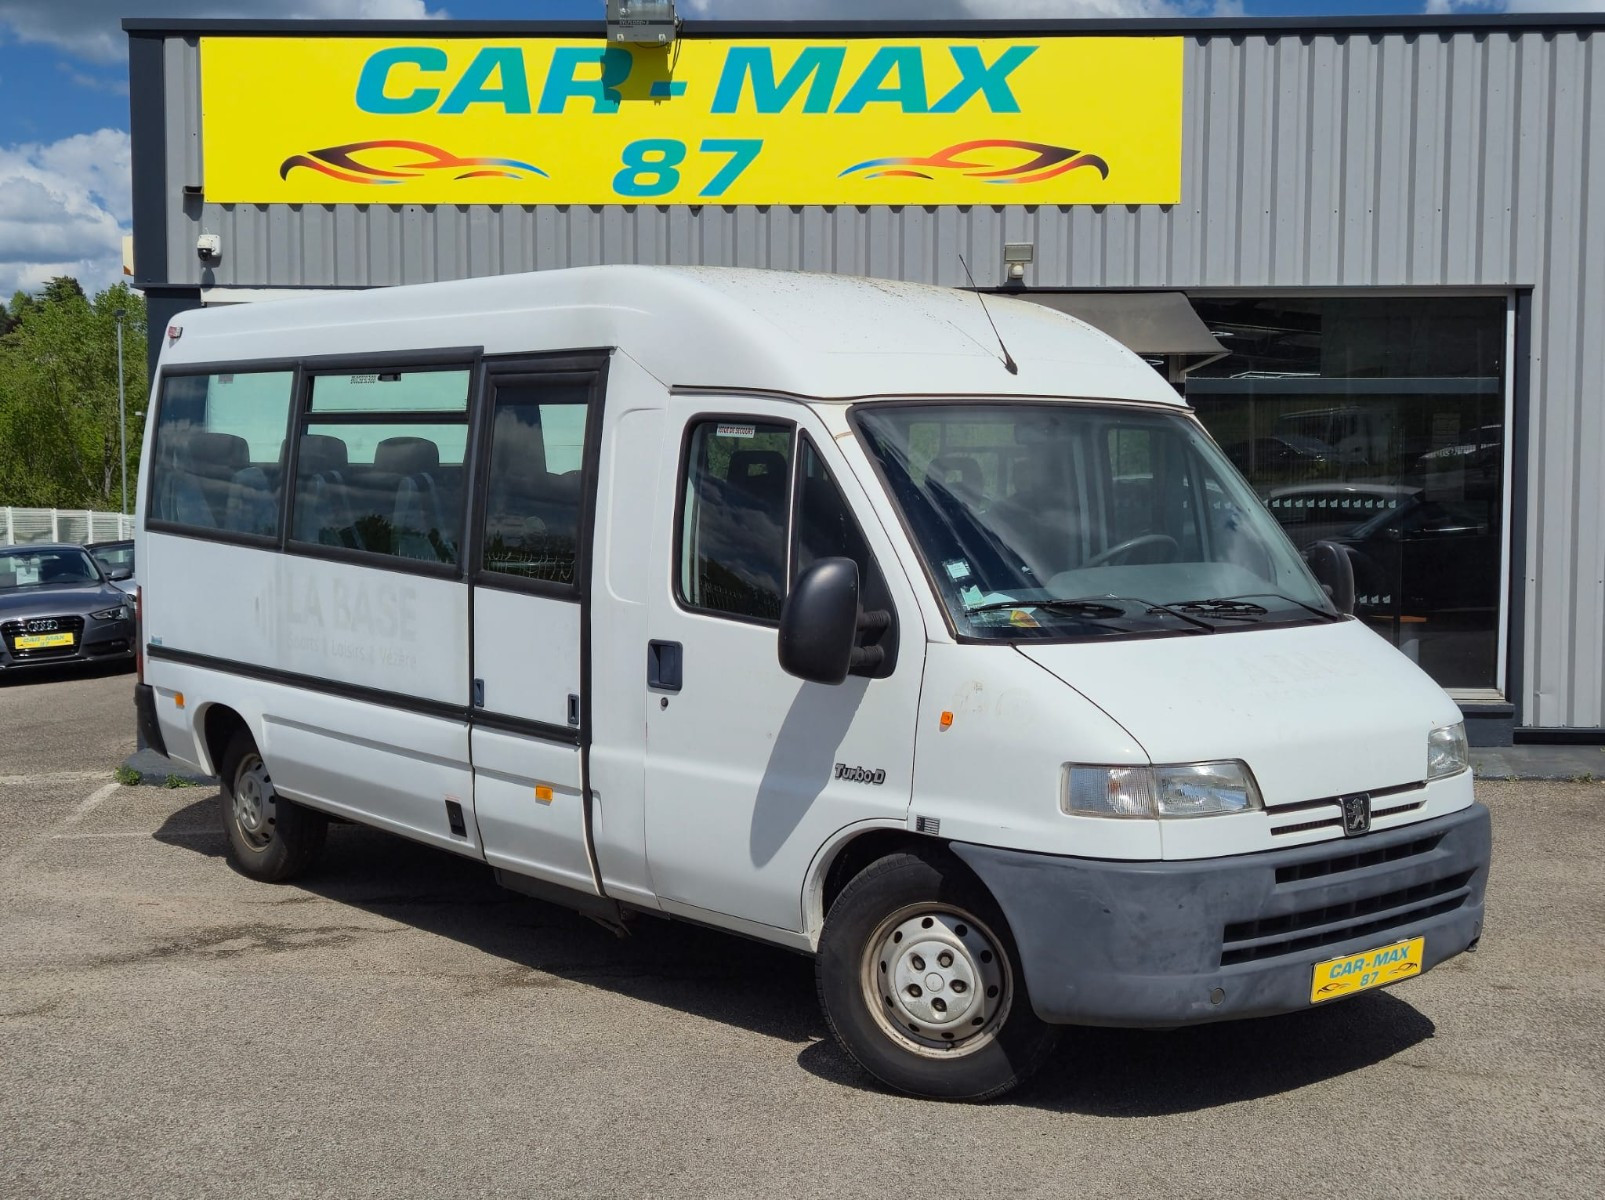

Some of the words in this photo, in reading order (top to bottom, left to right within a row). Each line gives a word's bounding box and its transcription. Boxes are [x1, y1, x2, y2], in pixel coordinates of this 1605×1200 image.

[612, 138, 764, 198] 87
[333, 577, 417, 642] BASE
[1360, 971, 1380, 987] 87
